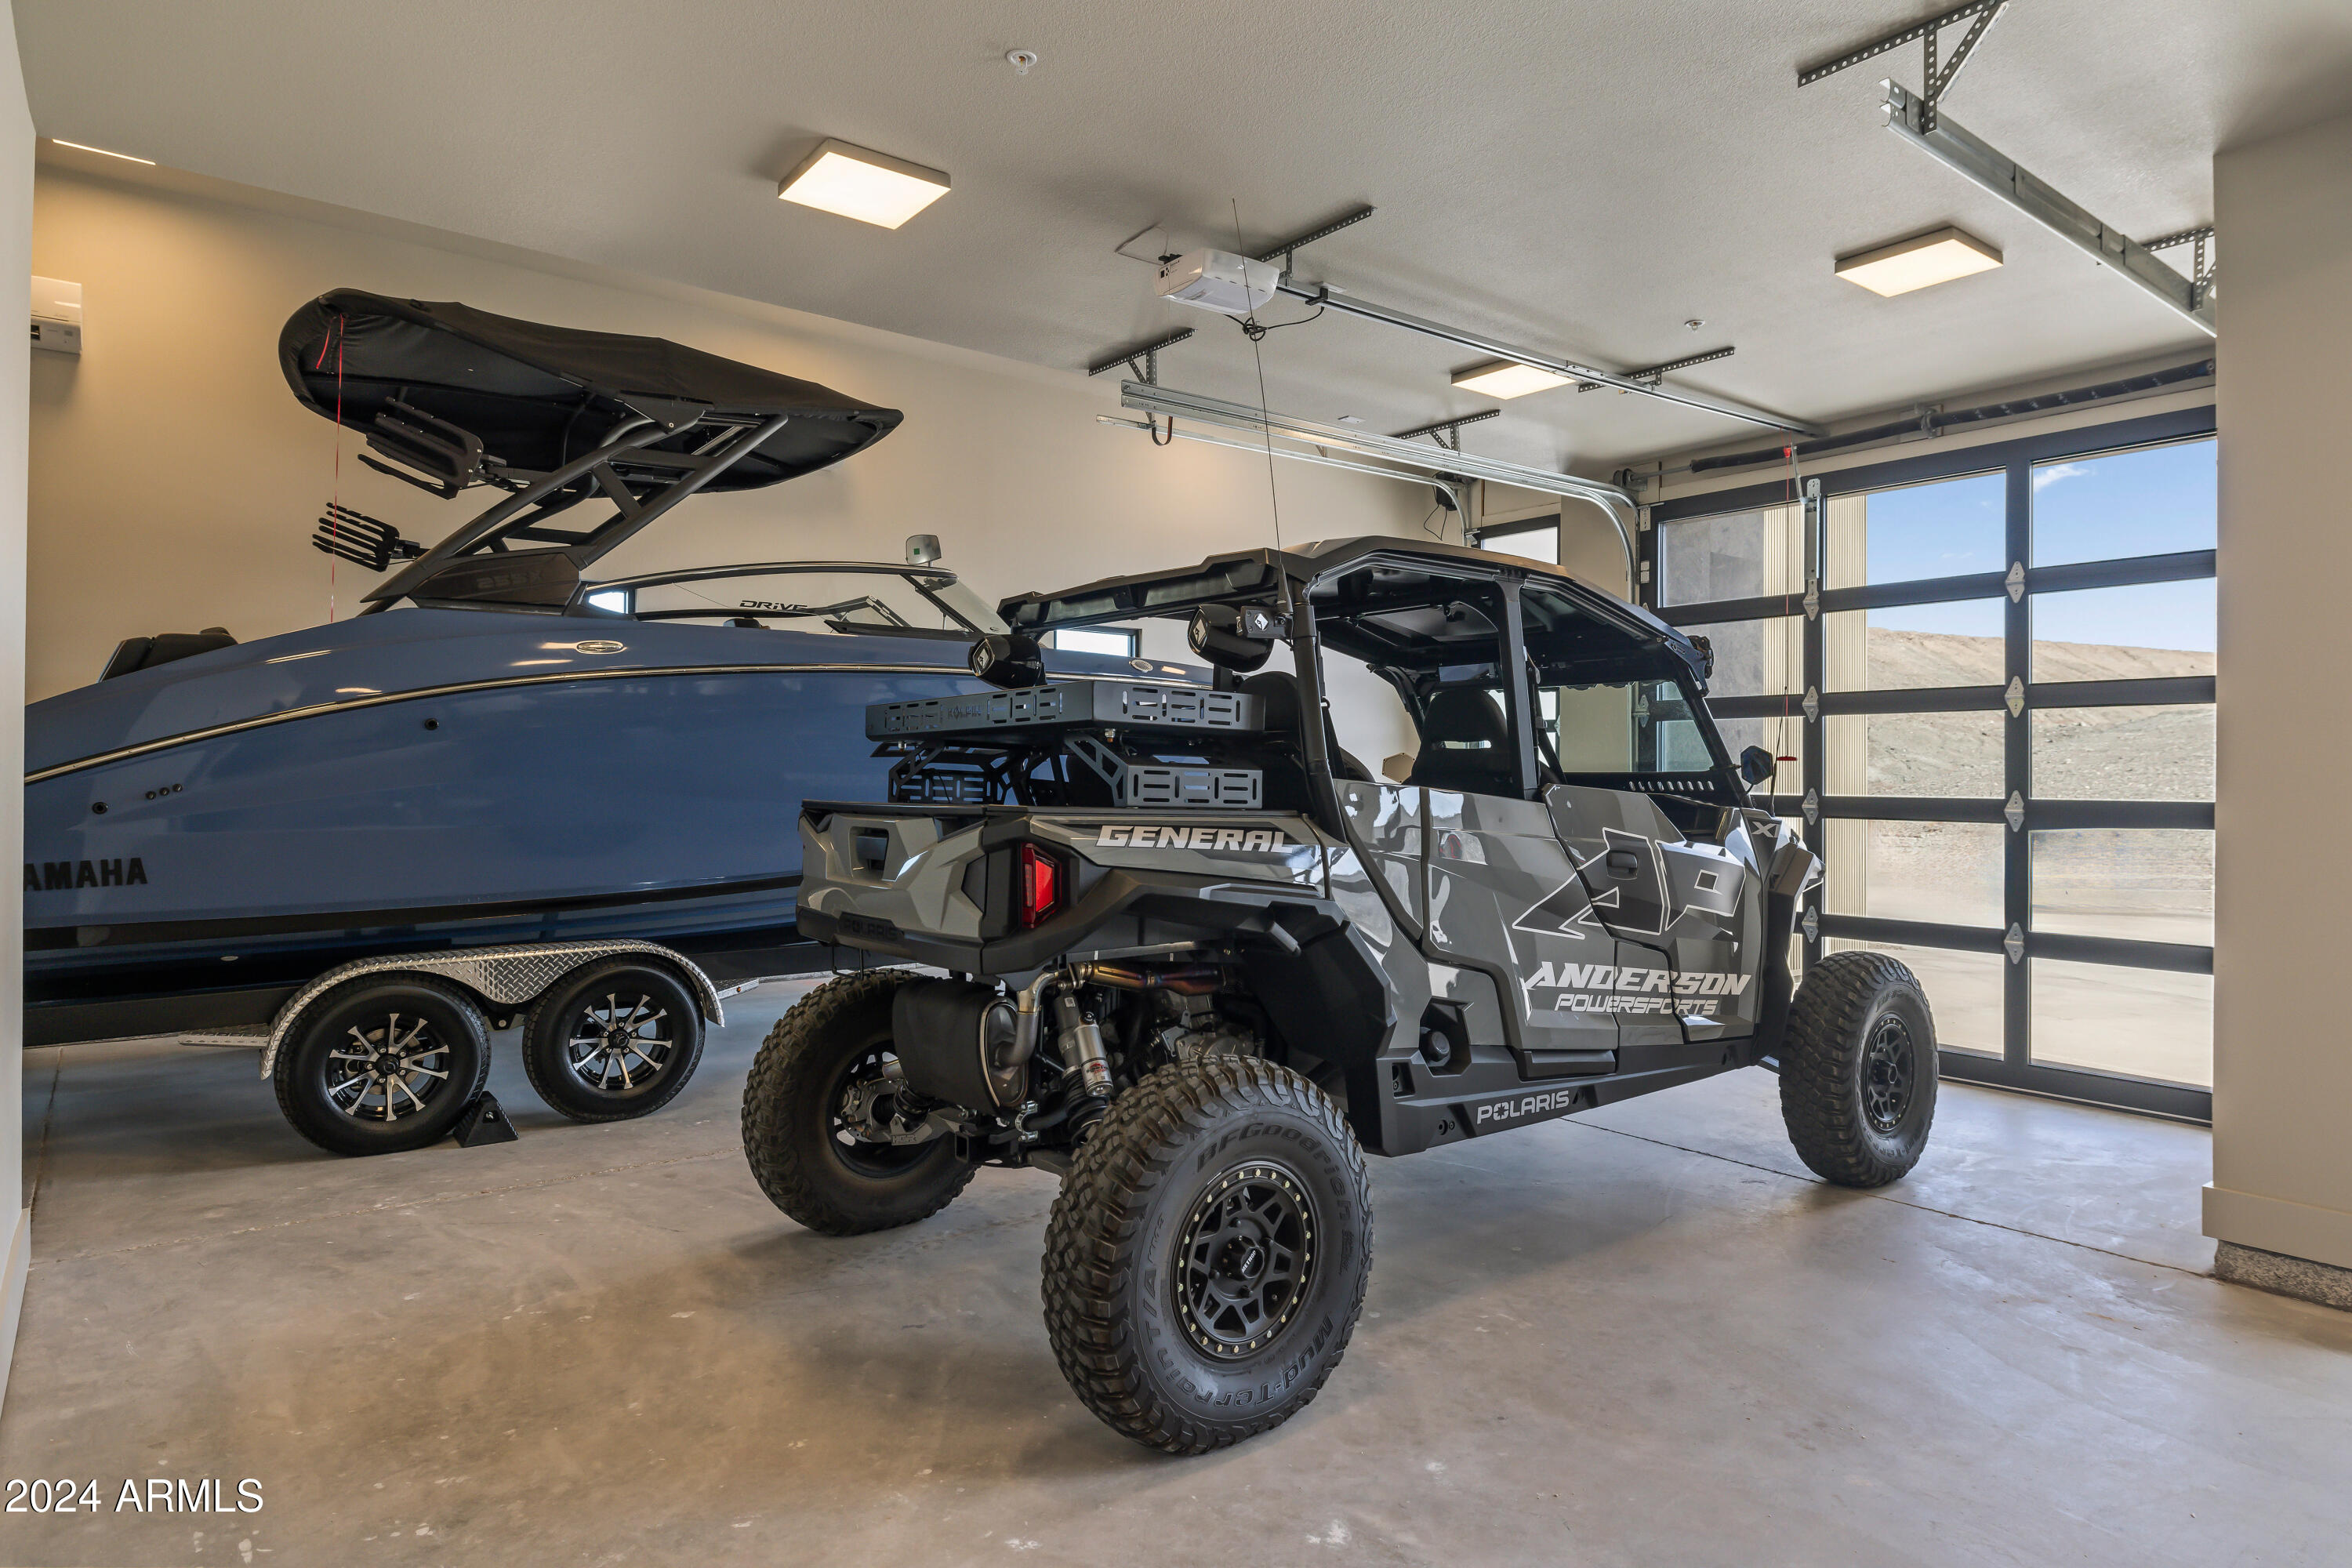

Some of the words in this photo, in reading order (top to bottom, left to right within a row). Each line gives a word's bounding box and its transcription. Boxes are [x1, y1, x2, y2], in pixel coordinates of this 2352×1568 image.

[1096, 825, 1294, 854] GENERAL
[24, 857, 148, 891] AMAHA
[840, 917, 899, 941] POLARIS
[1523, 961, 1751, 995] ANDERSON
[1555, 993, 1719, 1014] POWERSPORTS
[1477, 1091, 1570, 1124] POLARIS
[1241, 1250, 1257, 1273] METHOD
